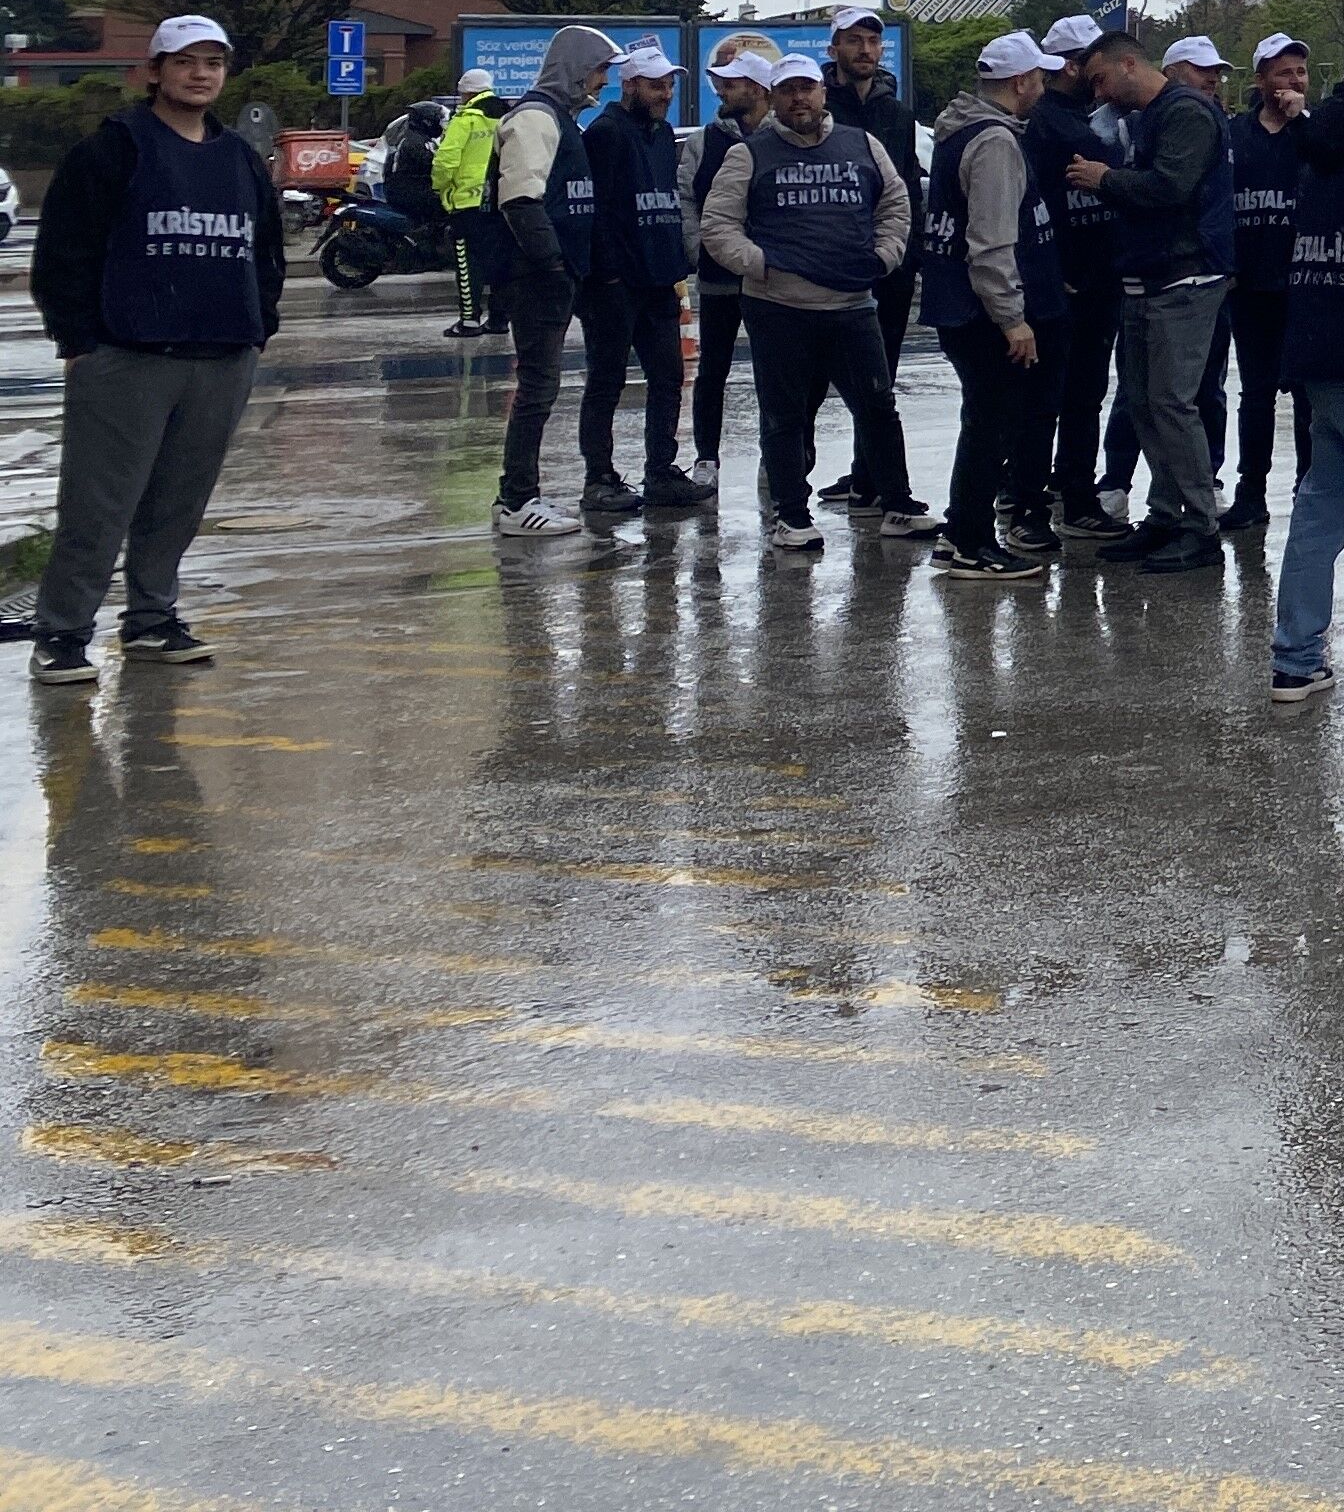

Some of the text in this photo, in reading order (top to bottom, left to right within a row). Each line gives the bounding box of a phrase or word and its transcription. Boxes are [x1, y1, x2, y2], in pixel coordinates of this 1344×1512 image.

[476, 40, 501, 52] Söz
[340, 61, 354, 78] P
[776, 186, 863, 207] SENDİKASI
[145, 242, 252, 262] SENDİKA
